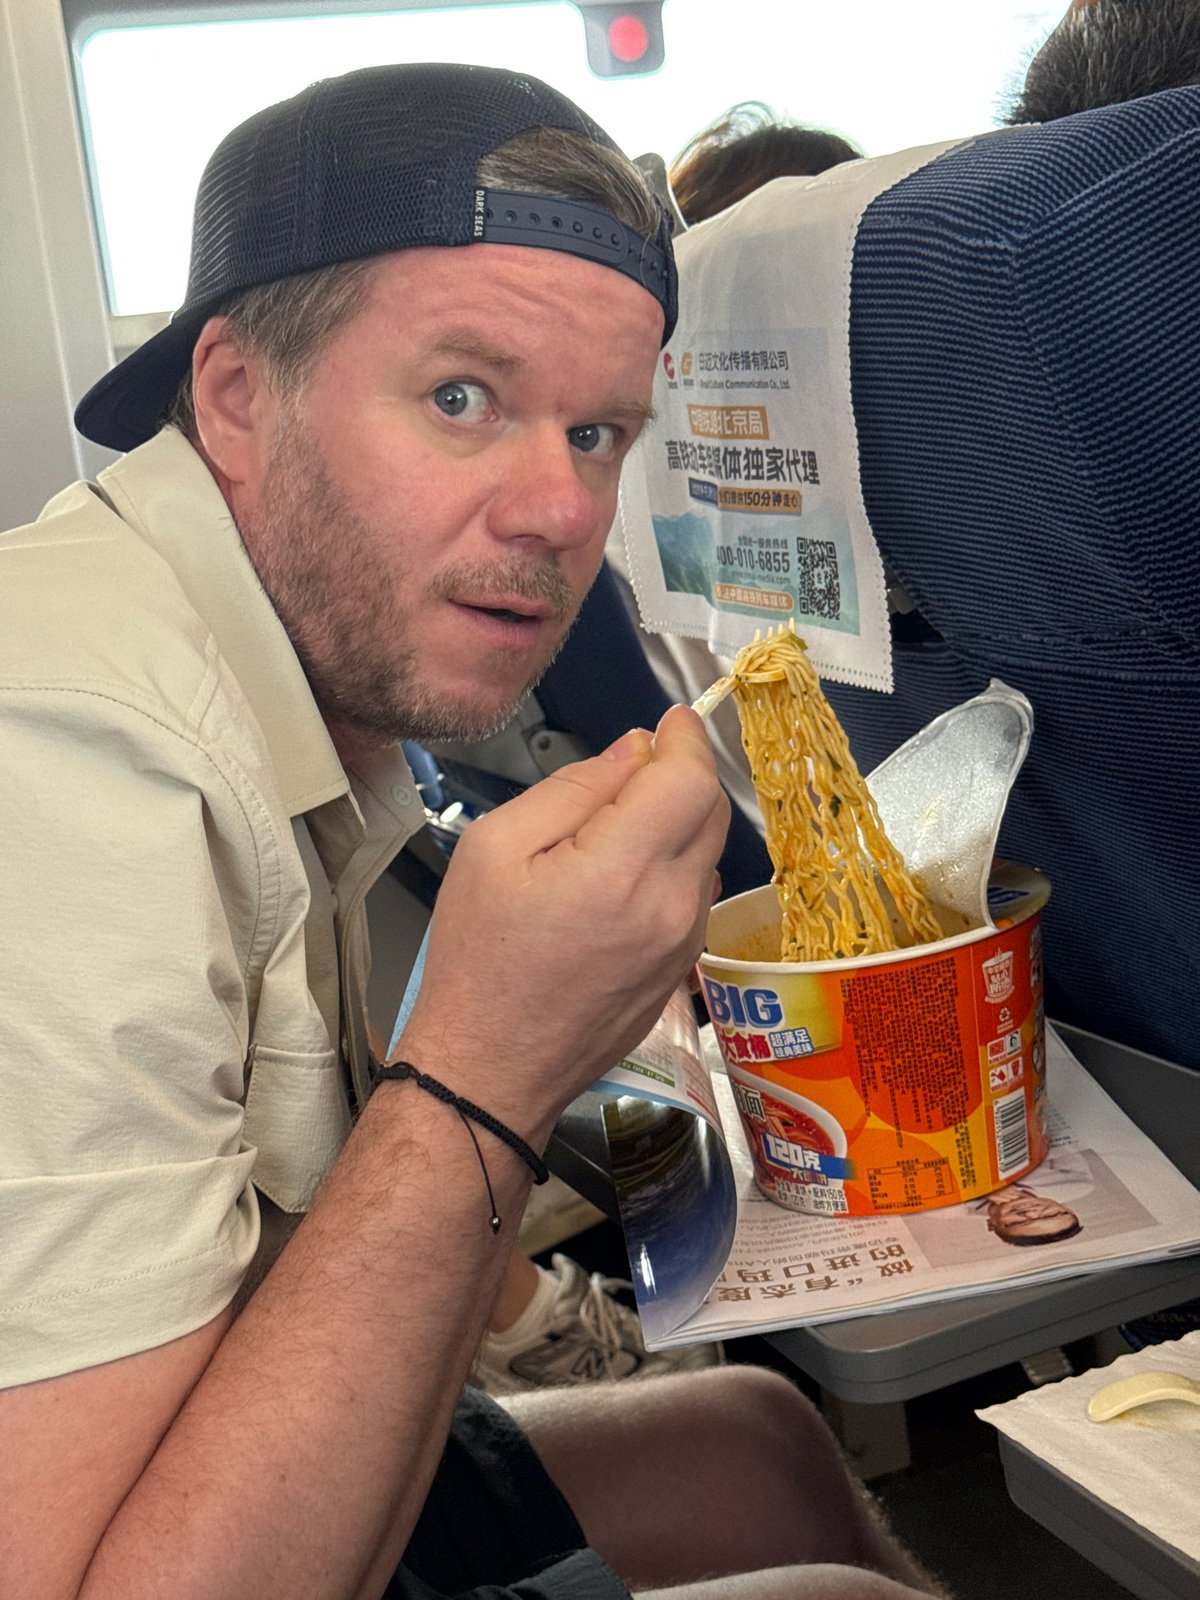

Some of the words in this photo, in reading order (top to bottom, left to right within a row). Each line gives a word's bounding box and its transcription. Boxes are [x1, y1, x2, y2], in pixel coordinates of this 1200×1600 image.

[475, 190, 485, 213] DARK
[473, 215, 484, 237] SEAS
[703, 977, 782, 1028] BIG
[770, 1029, 810, 1047] 超满足
[774, 1042, 814, 1058] 经典美味
[765, 1133, 821, 1171] 120克
